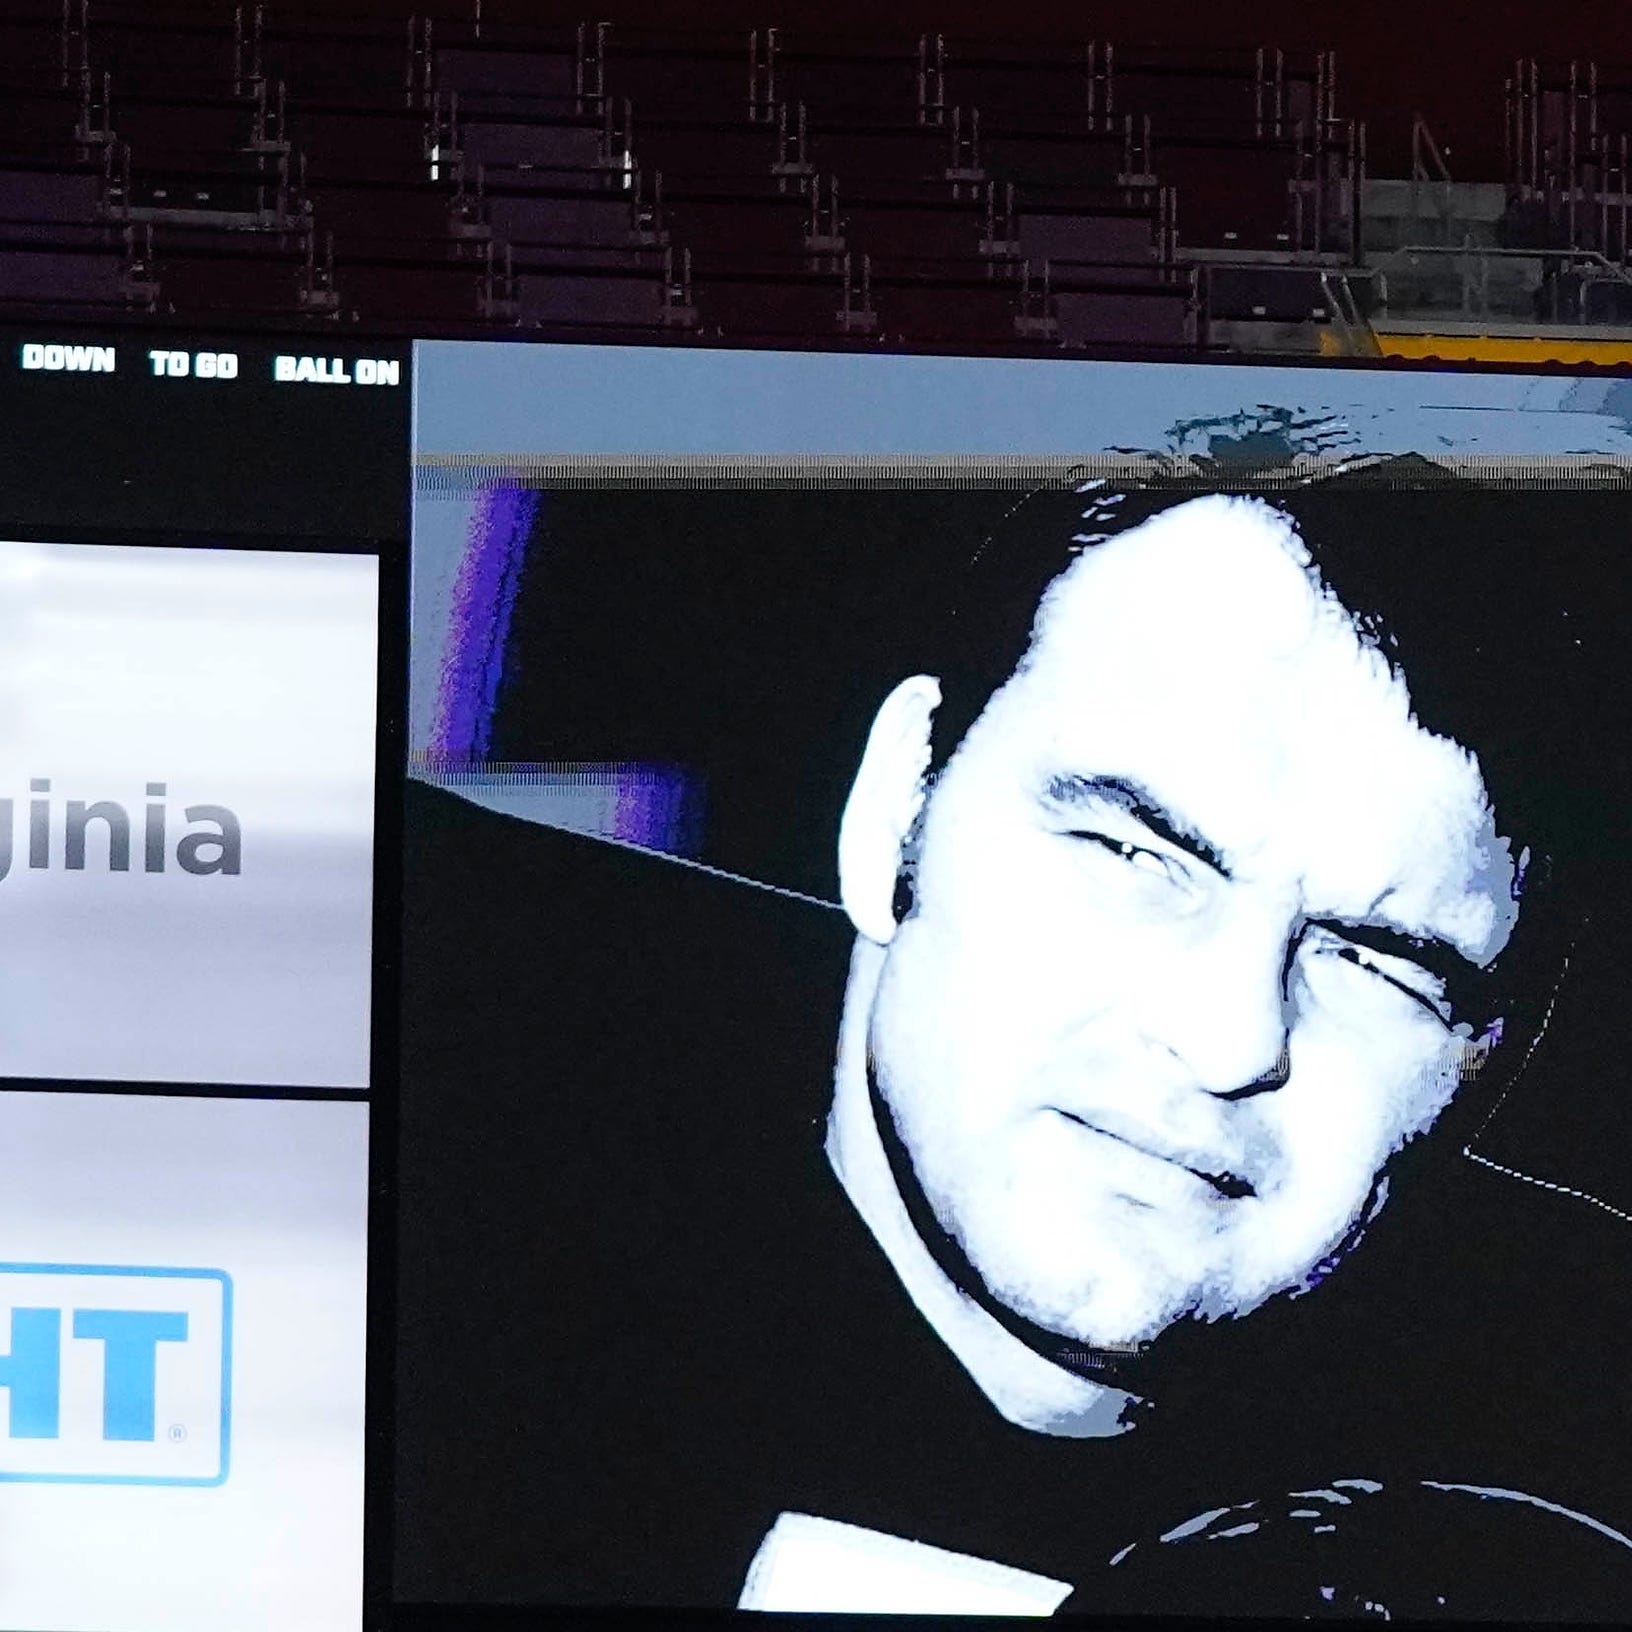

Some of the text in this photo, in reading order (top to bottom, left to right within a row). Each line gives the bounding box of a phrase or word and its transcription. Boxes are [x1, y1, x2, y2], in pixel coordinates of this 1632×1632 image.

[22, 343, 116, 373] DOWN
[148, 350, 239, 379] TO GO
[273, 355, 400, 387] BALL ON
